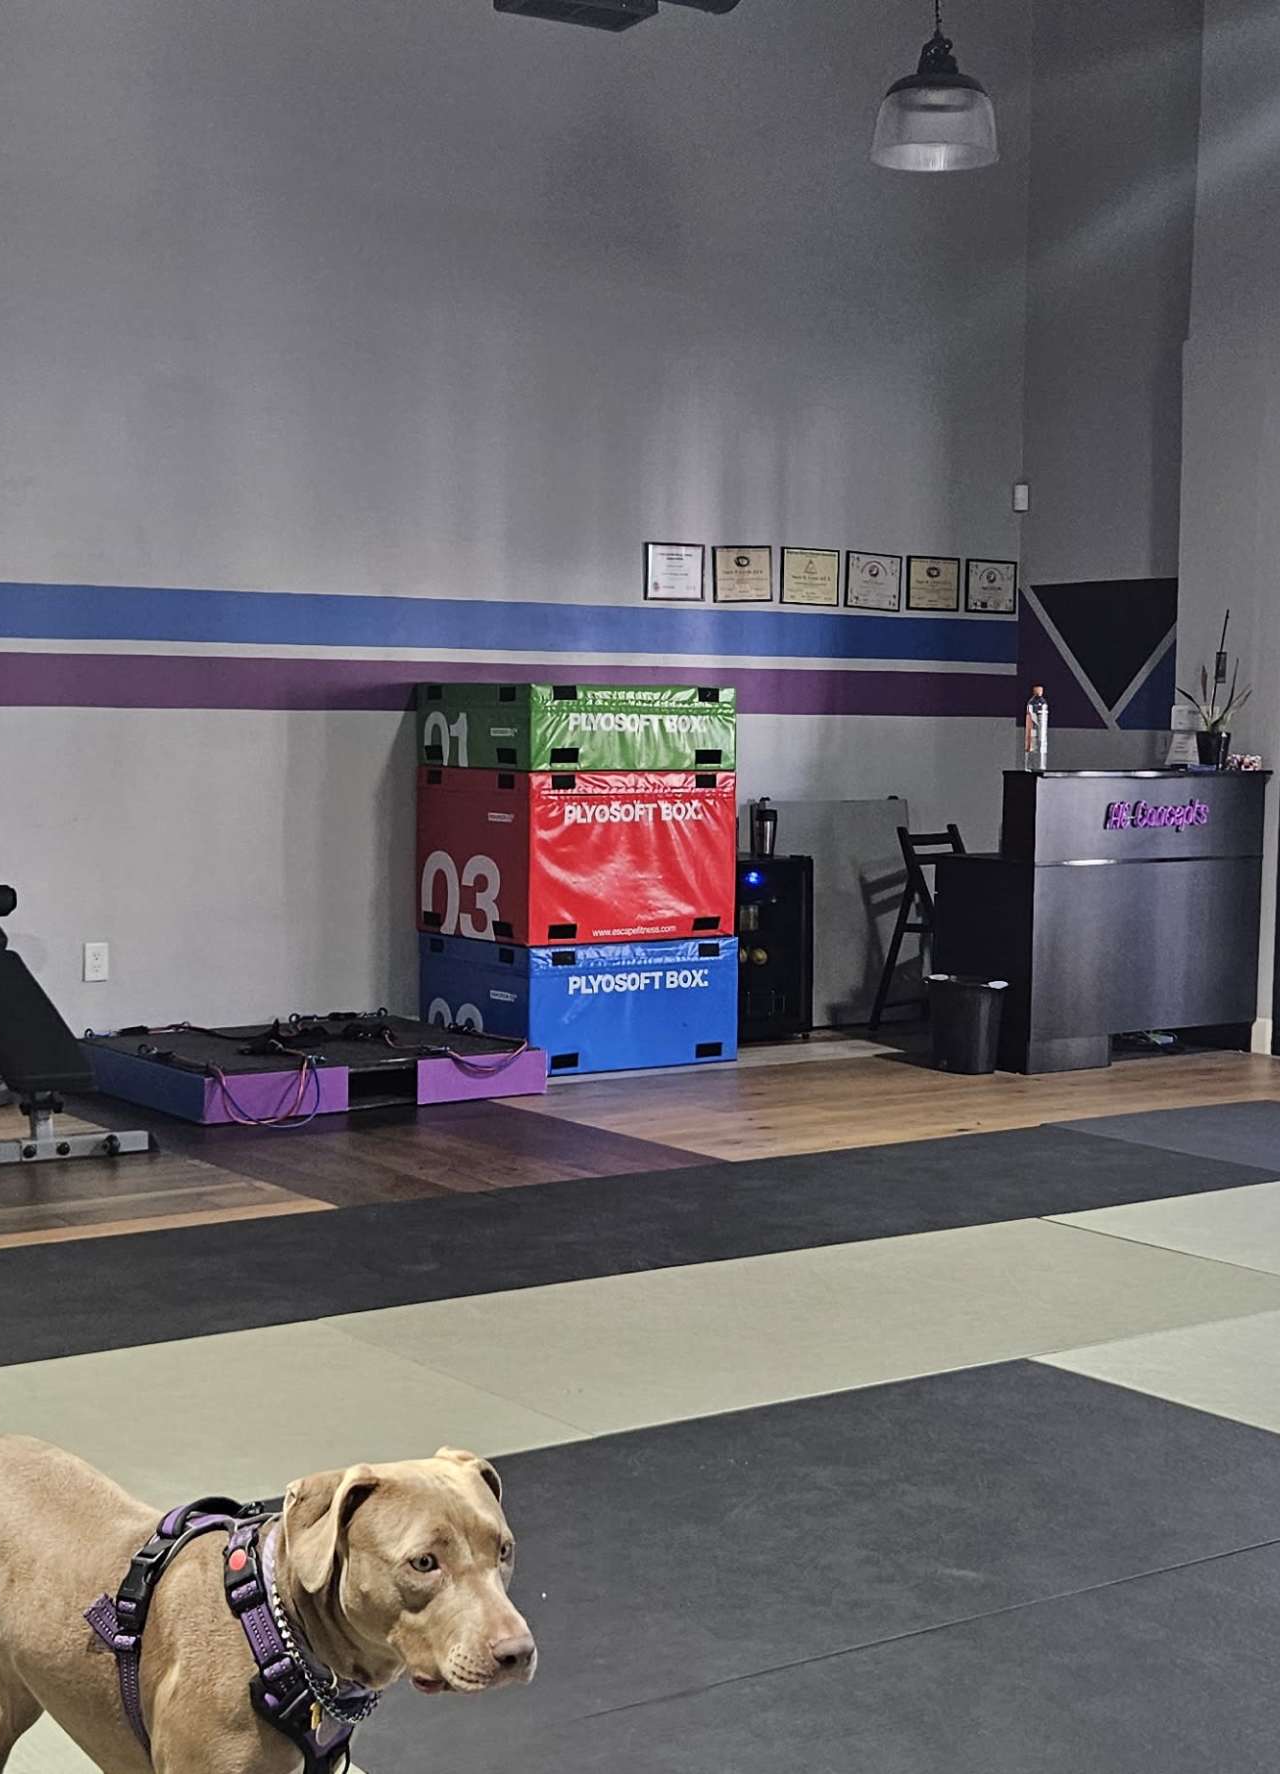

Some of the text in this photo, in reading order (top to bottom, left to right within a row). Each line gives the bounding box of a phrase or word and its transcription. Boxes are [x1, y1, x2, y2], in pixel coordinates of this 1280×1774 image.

[568, 713, 660, 732] PLYOSOFT
[424, 711, 468, 767] 01
[564, 802, 658, 825] PLYOSOFT
[421, 850, 500, 941] 03
[568, 972, 663, 995] PLYOSOFT
